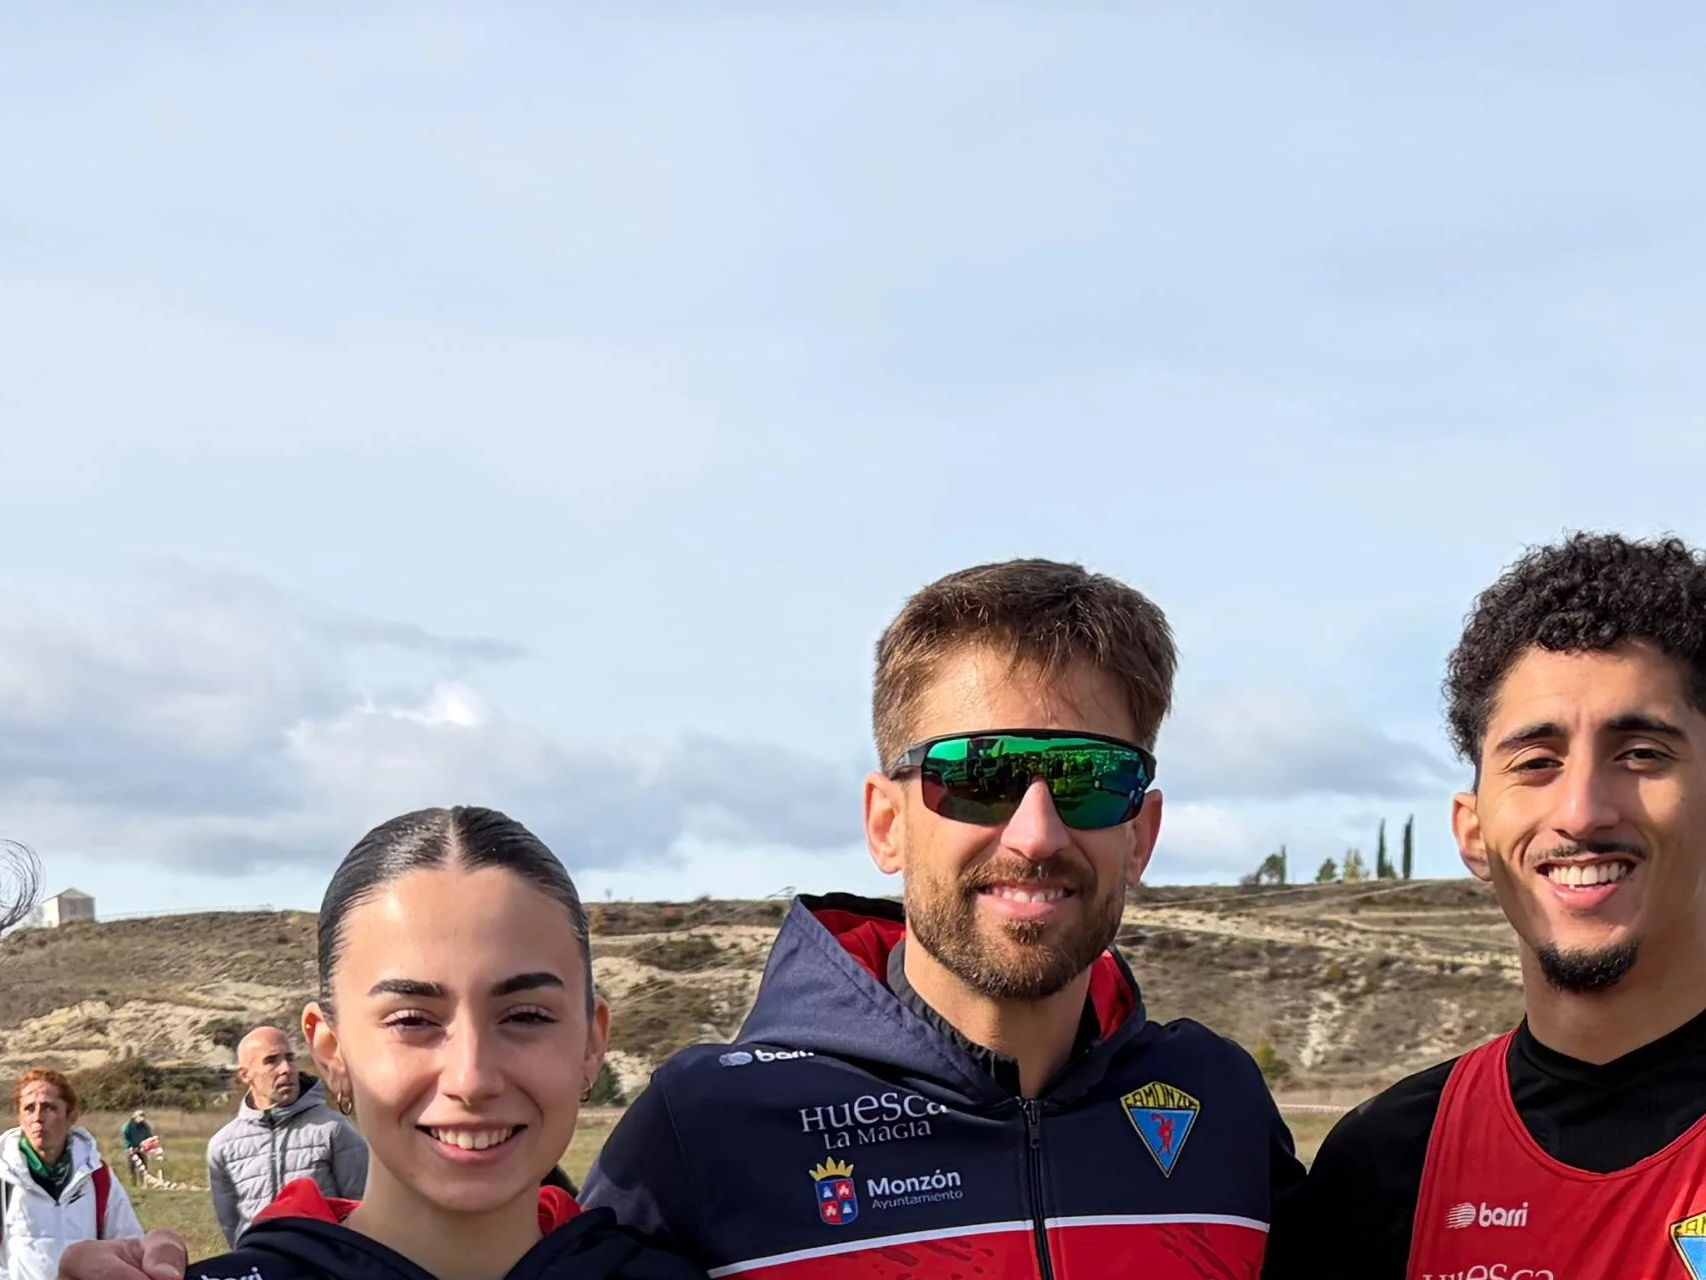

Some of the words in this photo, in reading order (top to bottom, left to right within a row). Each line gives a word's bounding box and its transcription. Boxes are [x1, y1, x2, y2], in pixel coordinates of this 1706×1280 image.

[867, 1169, 961, 1197] Monzón
[872, 1190, 964, 1210] Ayuntamiento
[1478, 1202, 1529, 1228] barri
